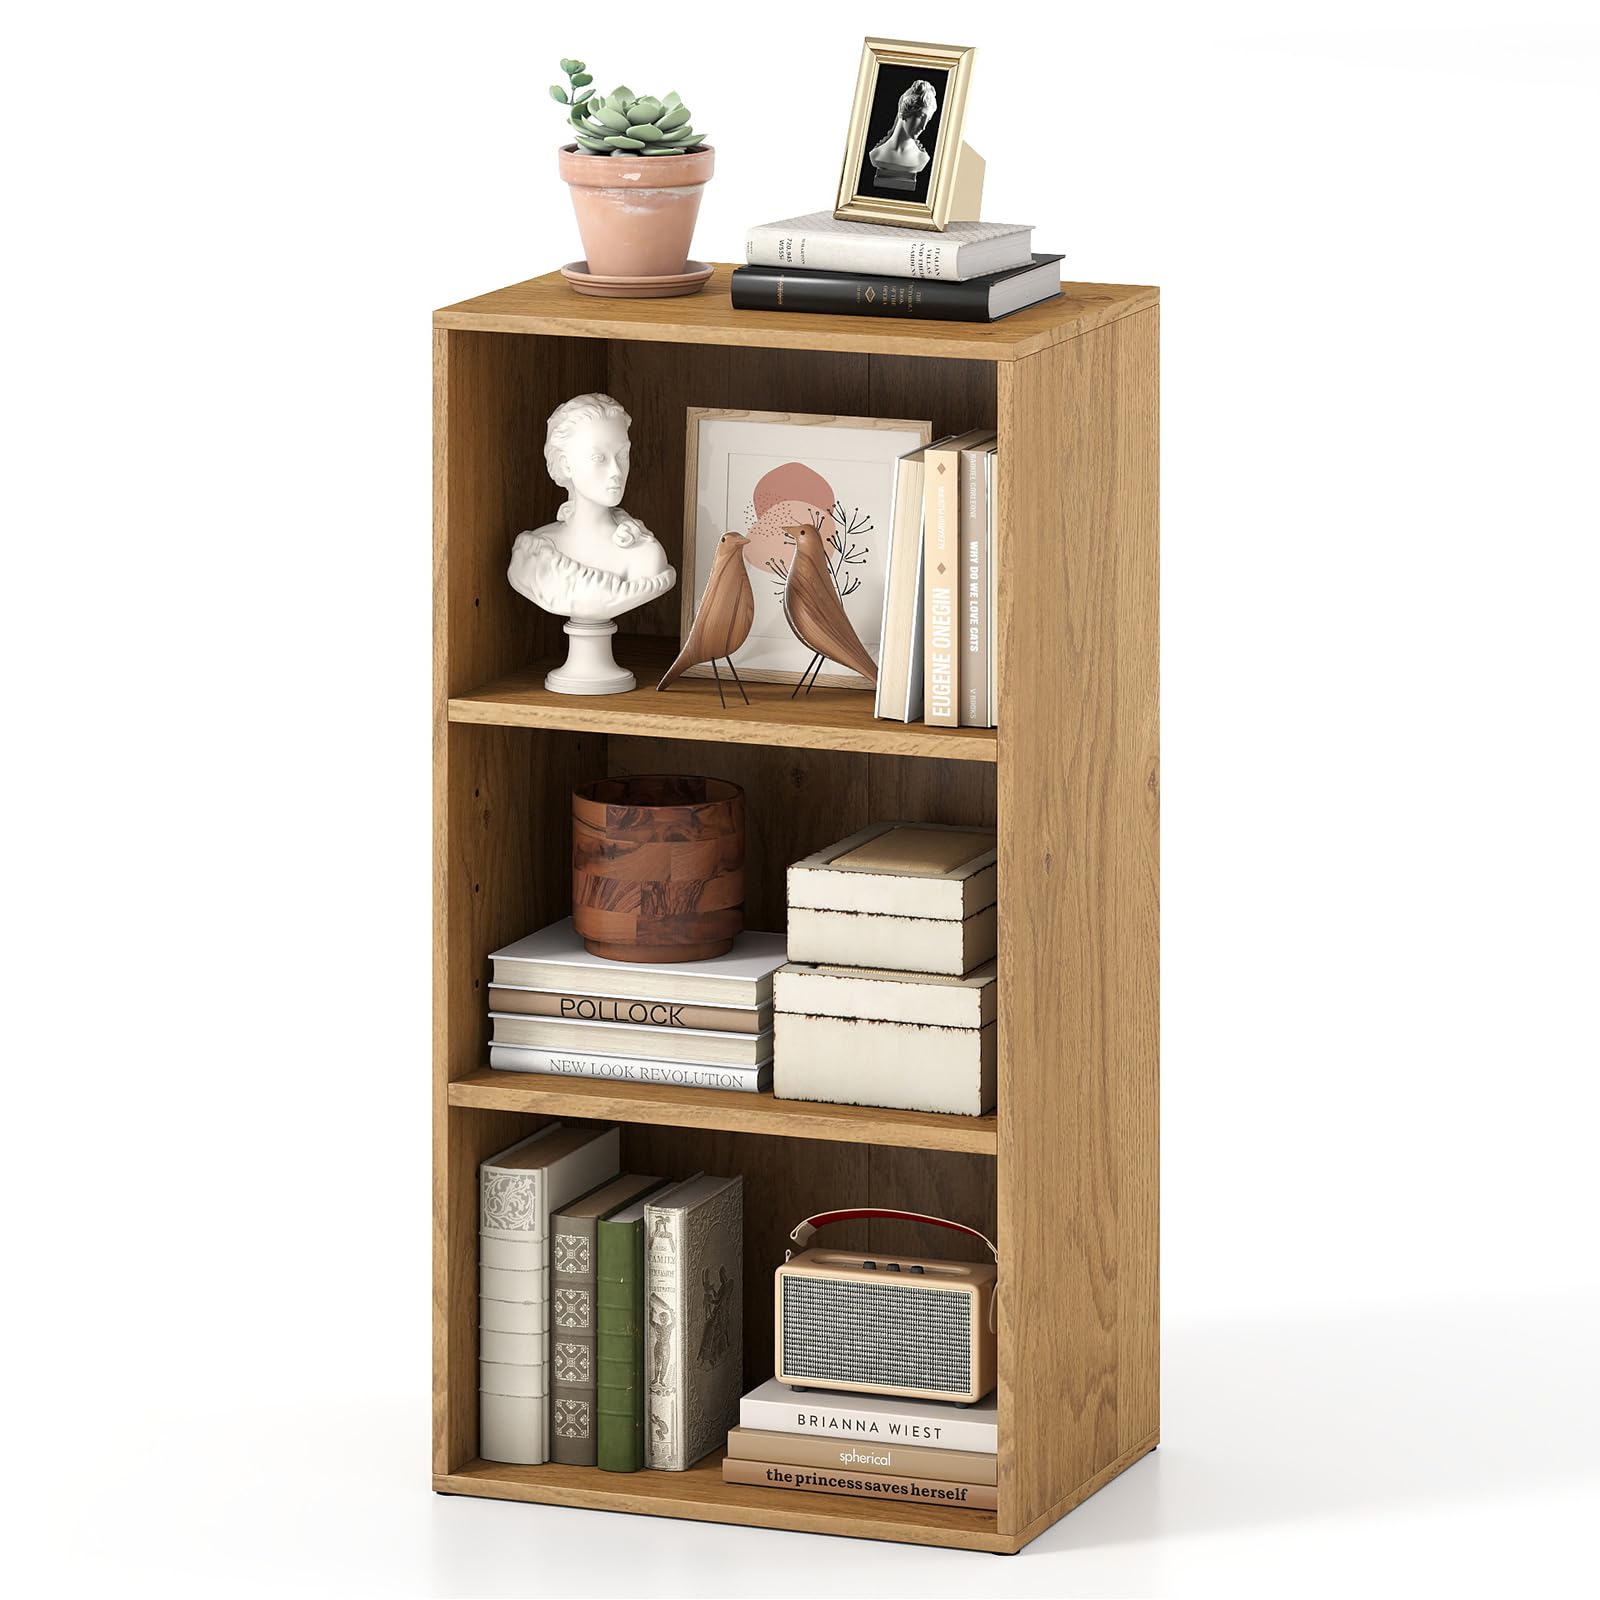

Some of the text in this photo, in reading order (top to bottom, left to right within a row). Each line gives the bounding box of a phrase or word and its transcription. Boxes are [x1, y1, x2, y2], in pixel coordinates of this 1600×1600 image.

[969, 541, 979, 652] WHY DO WE LOVE CATS
[931, 587, 952, 717] EUGENE ONEGIN
[560, 997, 686, 1026] POLLOCK
[549, 1058, 744, 1089] NEW LOOK REVOLUTION
[797, 1413, 942, 1440] BRIANNA WIEST
[839, 1448, 891, 1467] spherical
[766, 1468, 968, 1501] the princess saves herself
